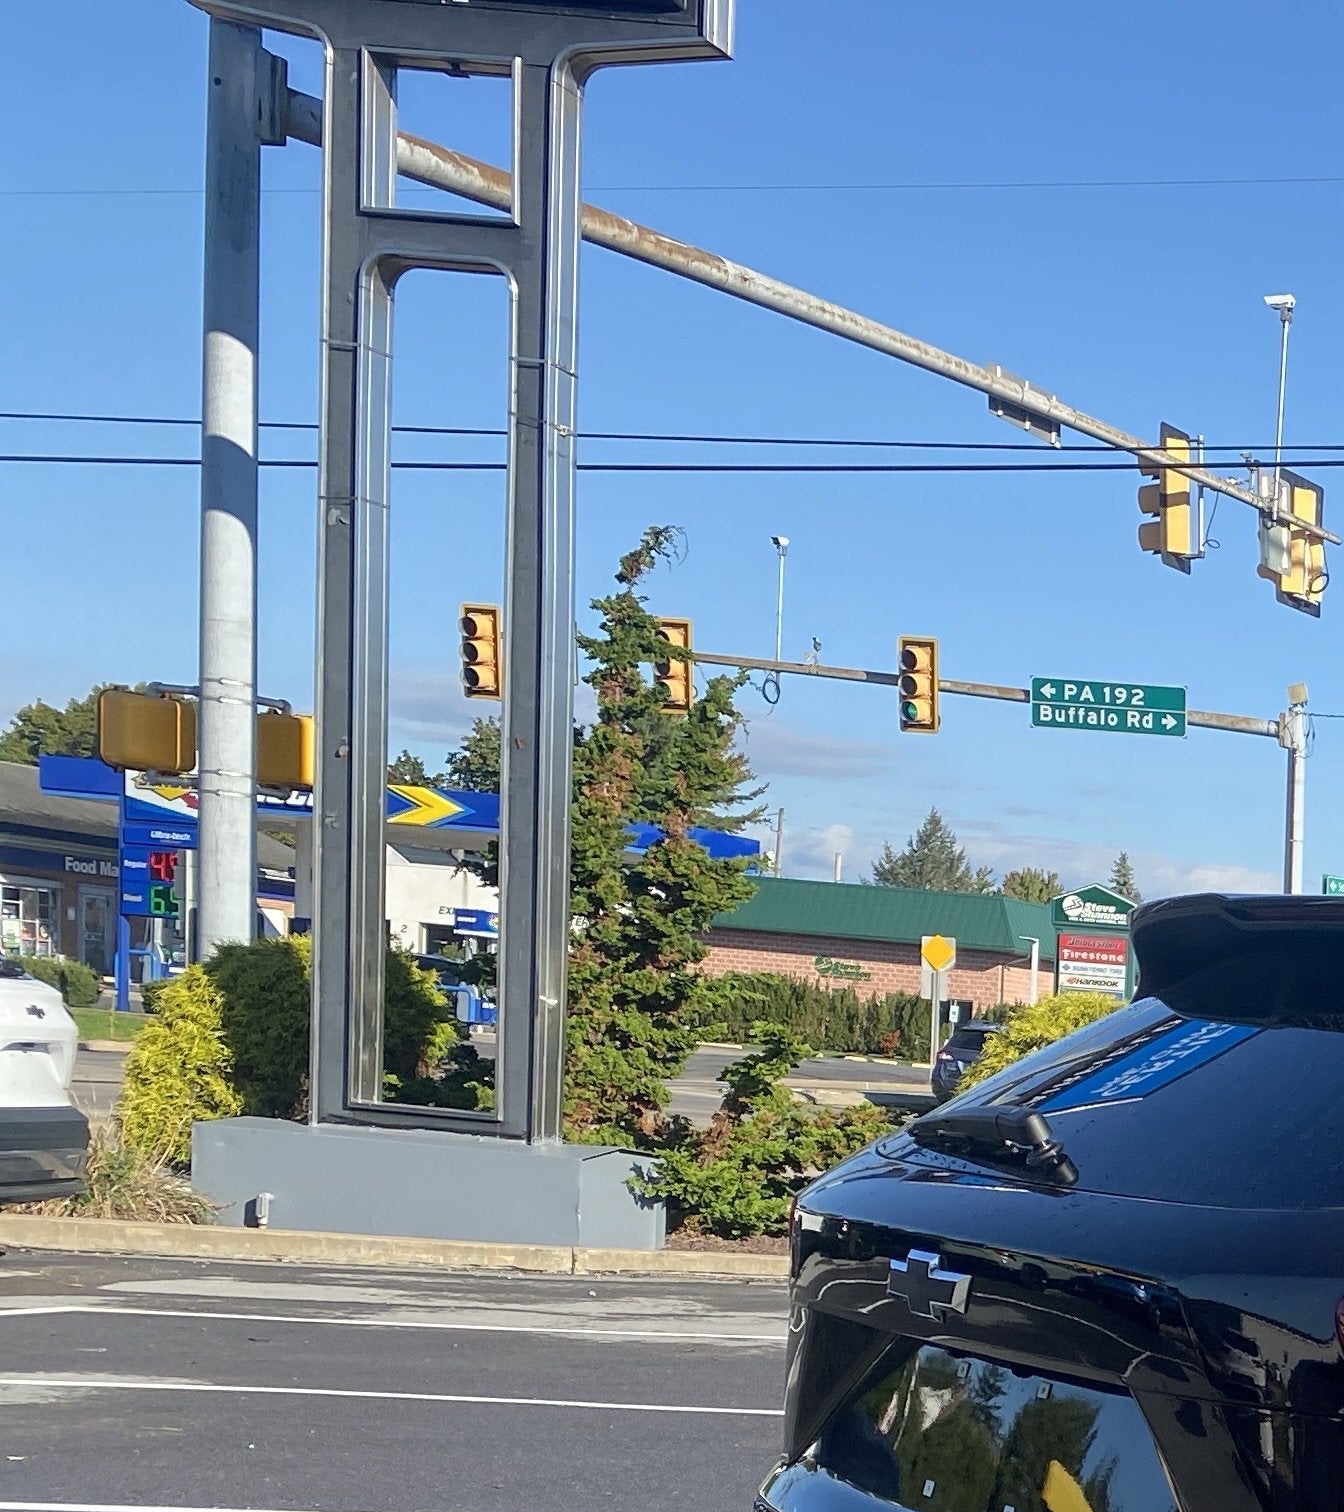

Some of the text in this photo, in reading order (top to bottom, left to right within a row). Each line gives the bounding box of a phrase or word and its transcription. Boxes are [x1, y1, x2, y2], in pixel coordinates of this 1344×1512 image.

[1064, 683, 1145, 705] PA 192
[1039, 704, 1153, 729] Buffalo Rd
[65, 856, 97, 874] Food
[438, 905, 454, 916] EX
[1084, 902, 1116, 912] Steve
[1080, 908, 1127, 921] Shannon
[1061, 948, 1124, 962] Firestone
